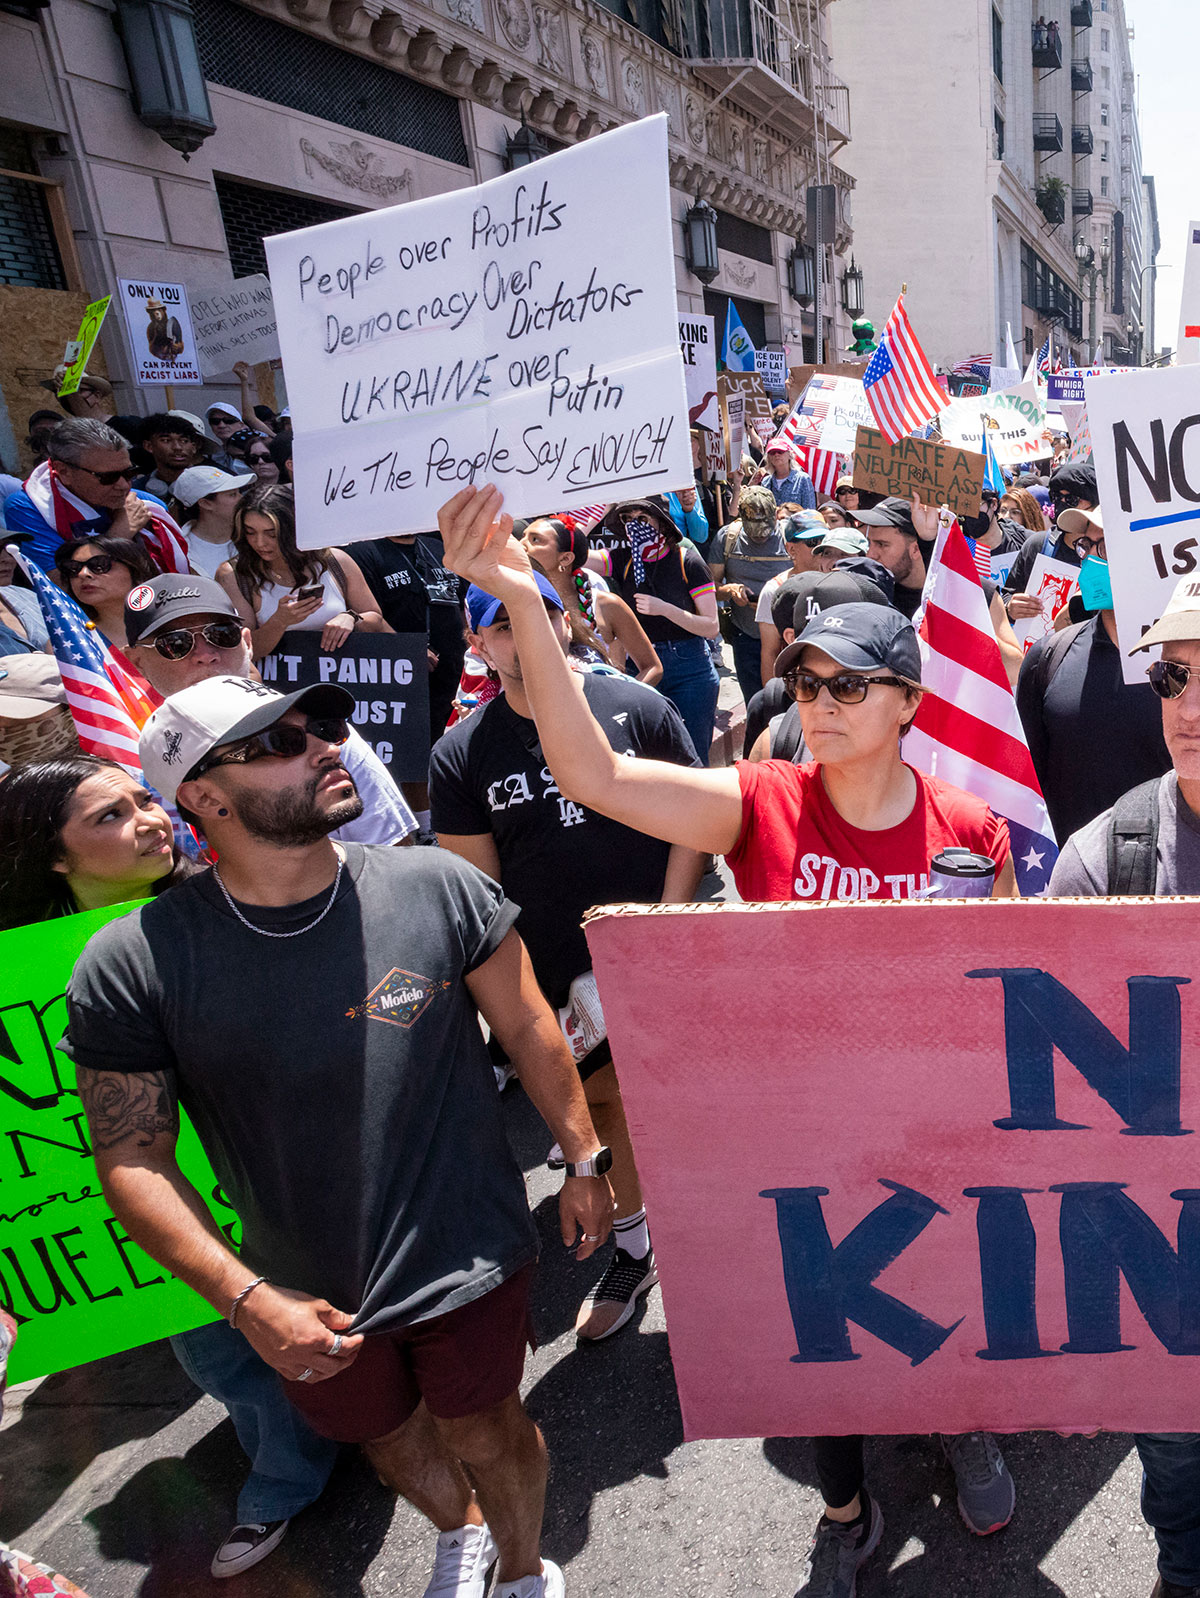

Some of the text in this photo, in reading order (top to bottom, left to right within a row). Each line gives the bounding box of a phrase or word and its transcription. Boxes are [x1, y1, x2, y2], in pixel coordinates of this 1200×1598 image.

[298, 180, 567, 302] People over Profits
[128, 284, 180, 301] ONLY YOU
[506, 266, 644, 341] Dictators
[324, 261, 542, 354] Democracy Over
[143, 361, 193, 369] CAN PREVENT
[755, 352, 784, 361] ICE OUT
[756, 361, 783, 370] OF LA!
[140, 370, 199, 380] FACIST LIARS
[340, 347, 570, 424] UKRAINE over
[728, 375, 764, 394] UCK
[548, 364, 625, 417] Putin
[1062, 389, 1085, 399] RIGHT
[961, 428, 1027, 442] BUIT THIS
[323, 415, 675, 507] We The People Say ENOUGH
[857, 429, 971, 474] I HATE A
[854, 452, 982, 496] NEUTRAL ASS
[887, 478, 959, 511] BITCH
[1152, 537, 1199, 580] IS
[155, 586, 202, 608] Guild
[823, 616, 844, 628] OR
[258, 653, 414, 686] N'T PANIC
[222, 678, 278, 697] LA
[351, 700, 406, 725] UST
[556, 797, 585, 828] LA
[794, 852, 928, 901] STOP TH
[380, 987, 424, 1010] Modelo
